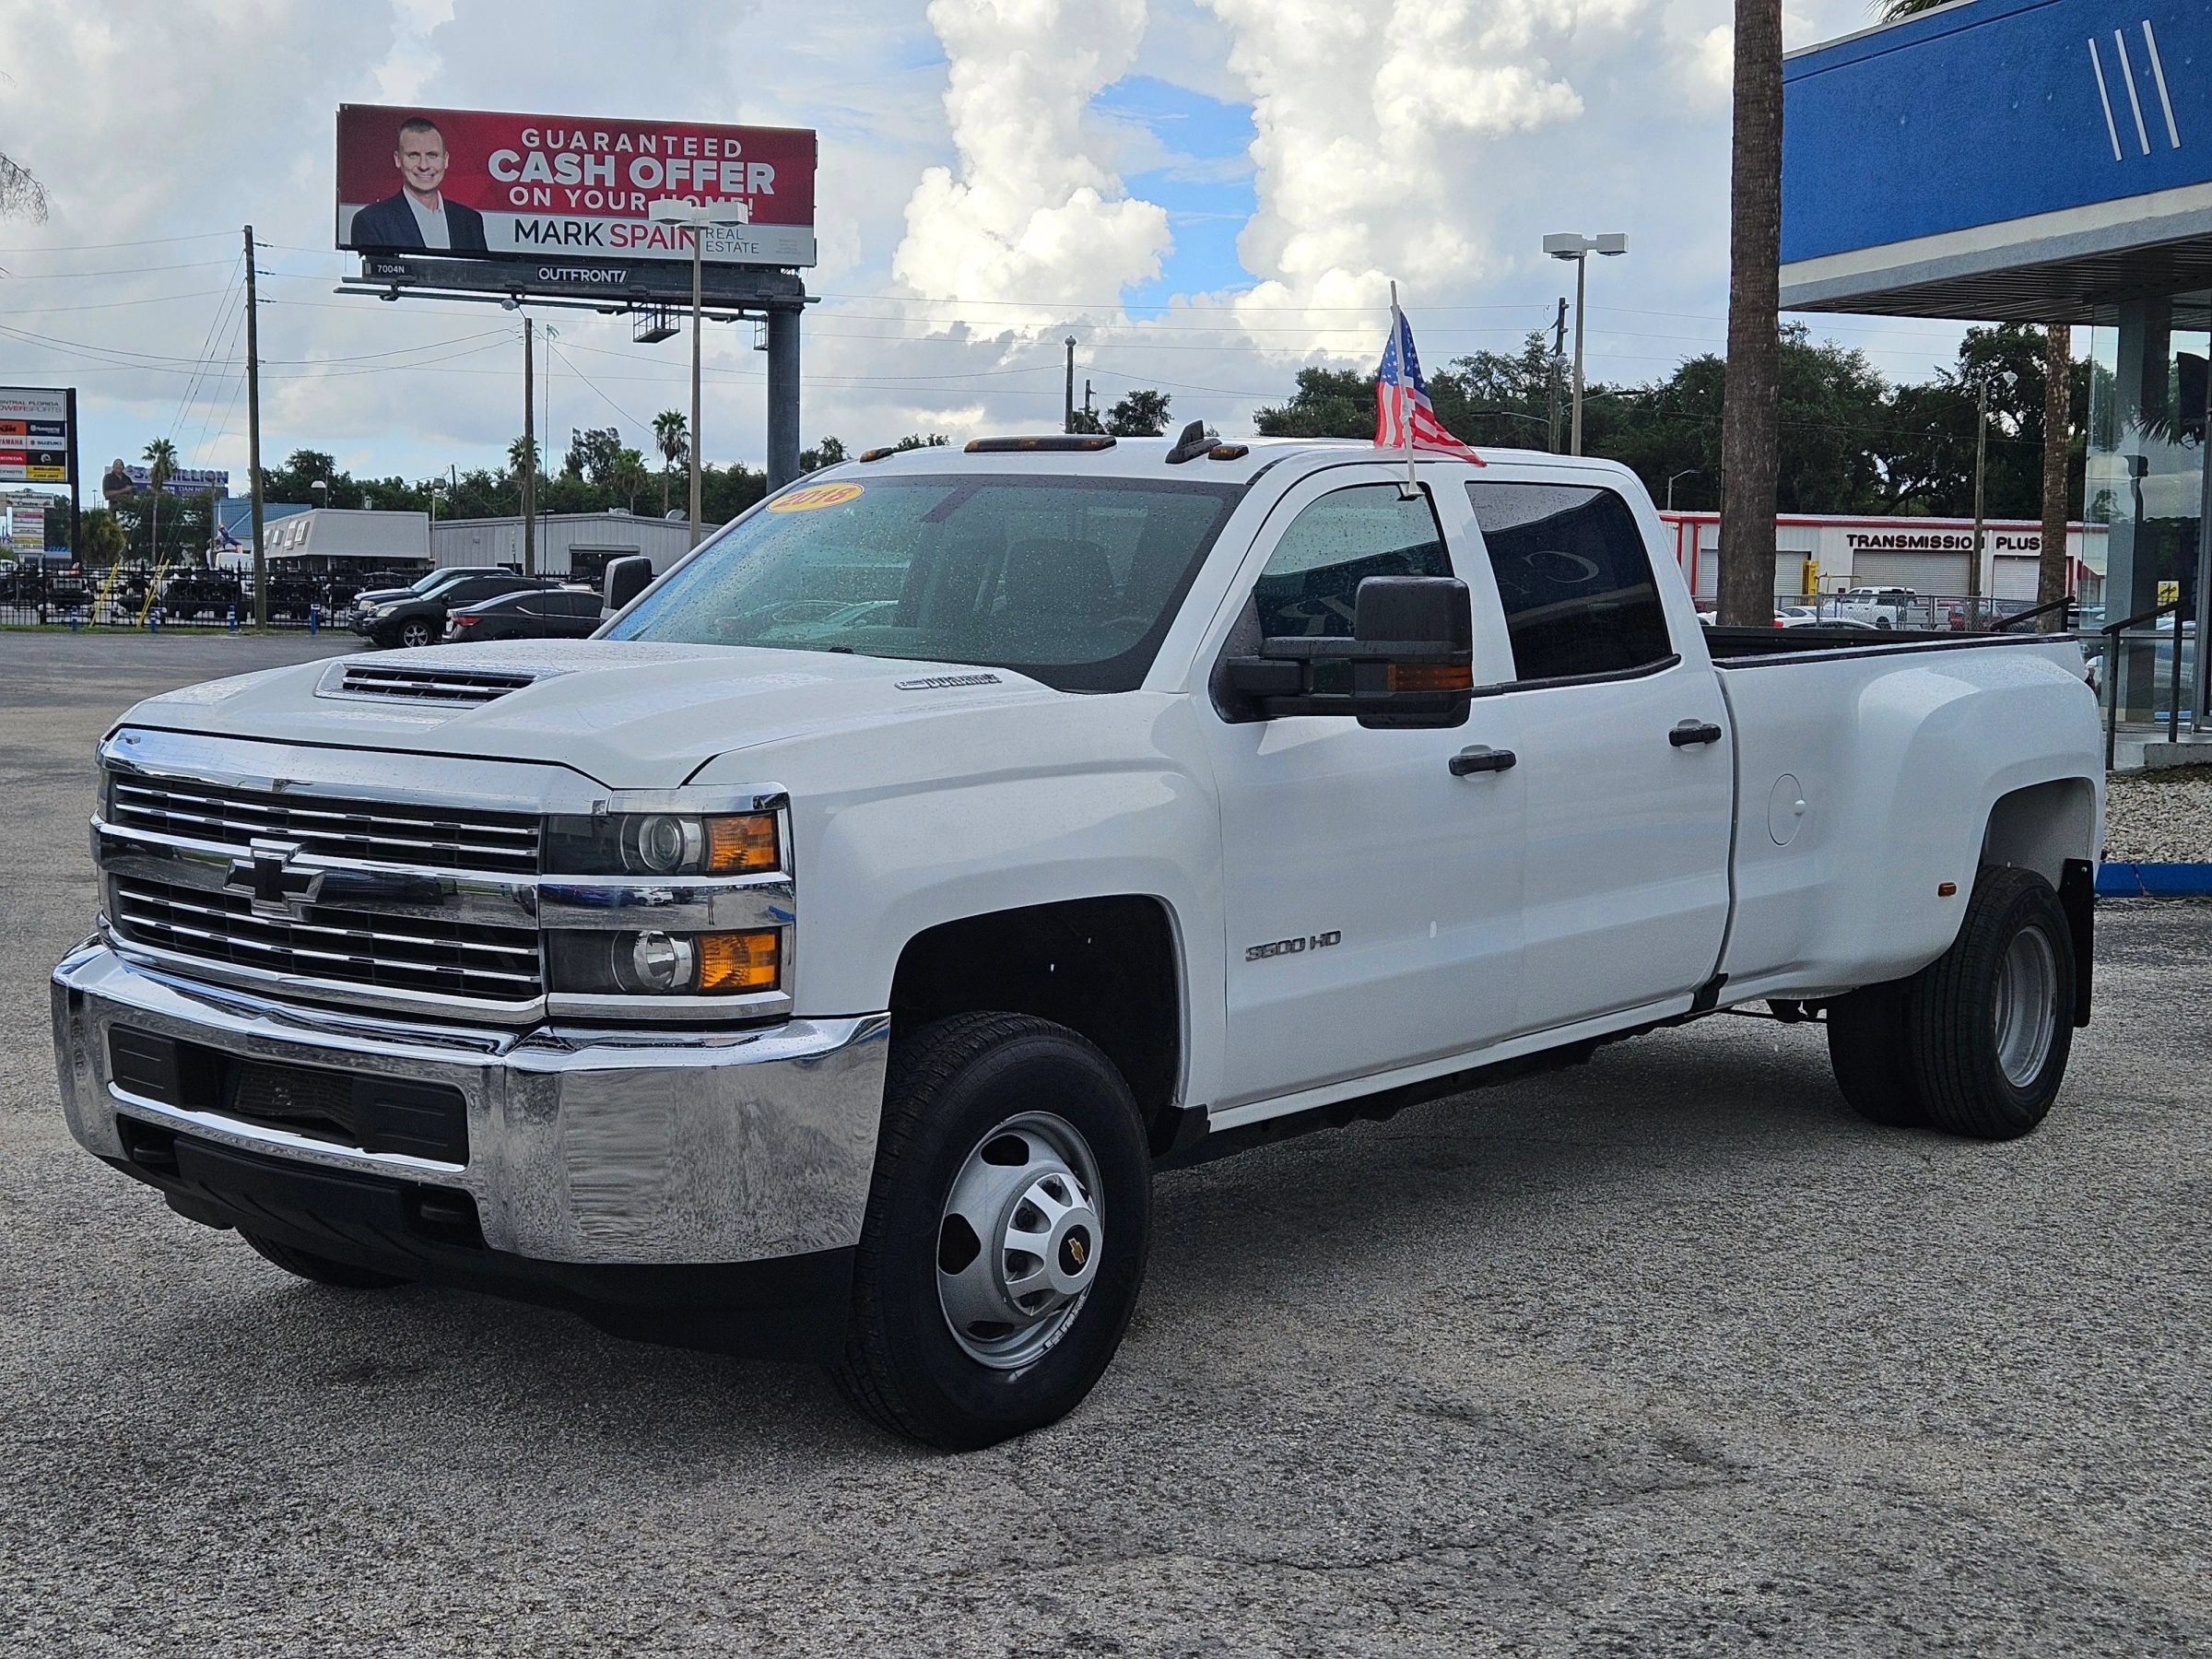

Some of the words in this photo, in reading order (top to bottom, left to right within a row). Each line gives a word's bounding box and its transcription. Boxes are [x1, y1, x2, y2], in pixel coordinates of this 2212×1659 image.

[521, 128, 742, 158] GUARANTEED
[488, 148, 616, 187] CASH
[629, 156, 775, 194] OFFER
[509, 186, 551, 206] ON
[565, 189, 645, 211] YOUR
[514, 218, 605, 246] MARK
[609, 224, 695, 251] SPAIN
[705, 228, 745, 241] REAL
[705, 241, 759, 254] ESTATE
[377, 265, 406, 274] 7004N
[1995, 536, 2041, 550] PLUS
[1245, 937, 1305, 961] 3500
[1310, 930, 1341, 950] HD
